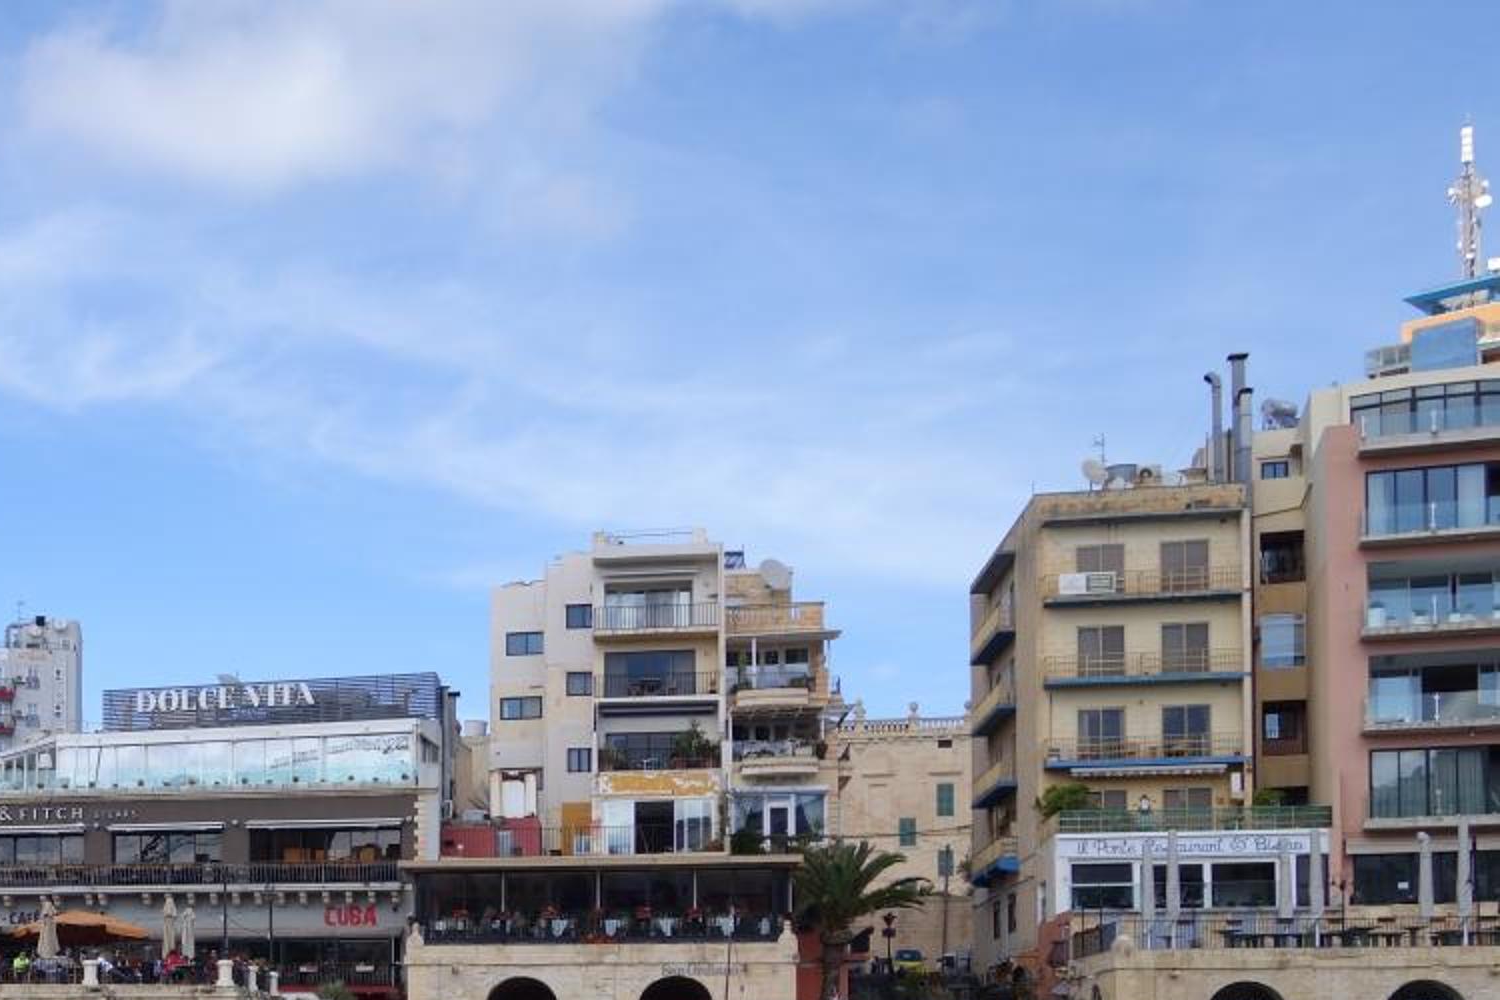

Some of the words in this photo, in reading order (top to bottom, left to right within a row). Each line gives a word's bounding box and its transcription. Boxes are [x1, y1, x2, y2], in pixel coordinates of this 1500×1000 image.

[137, 685, 235, 712] DOLCE
[243, 682, 315, 707] VITA
[0, 806, 12, 821] &
[19, 807, 83, 821] FITCH
[324, 903, 377, 927] CUBA
